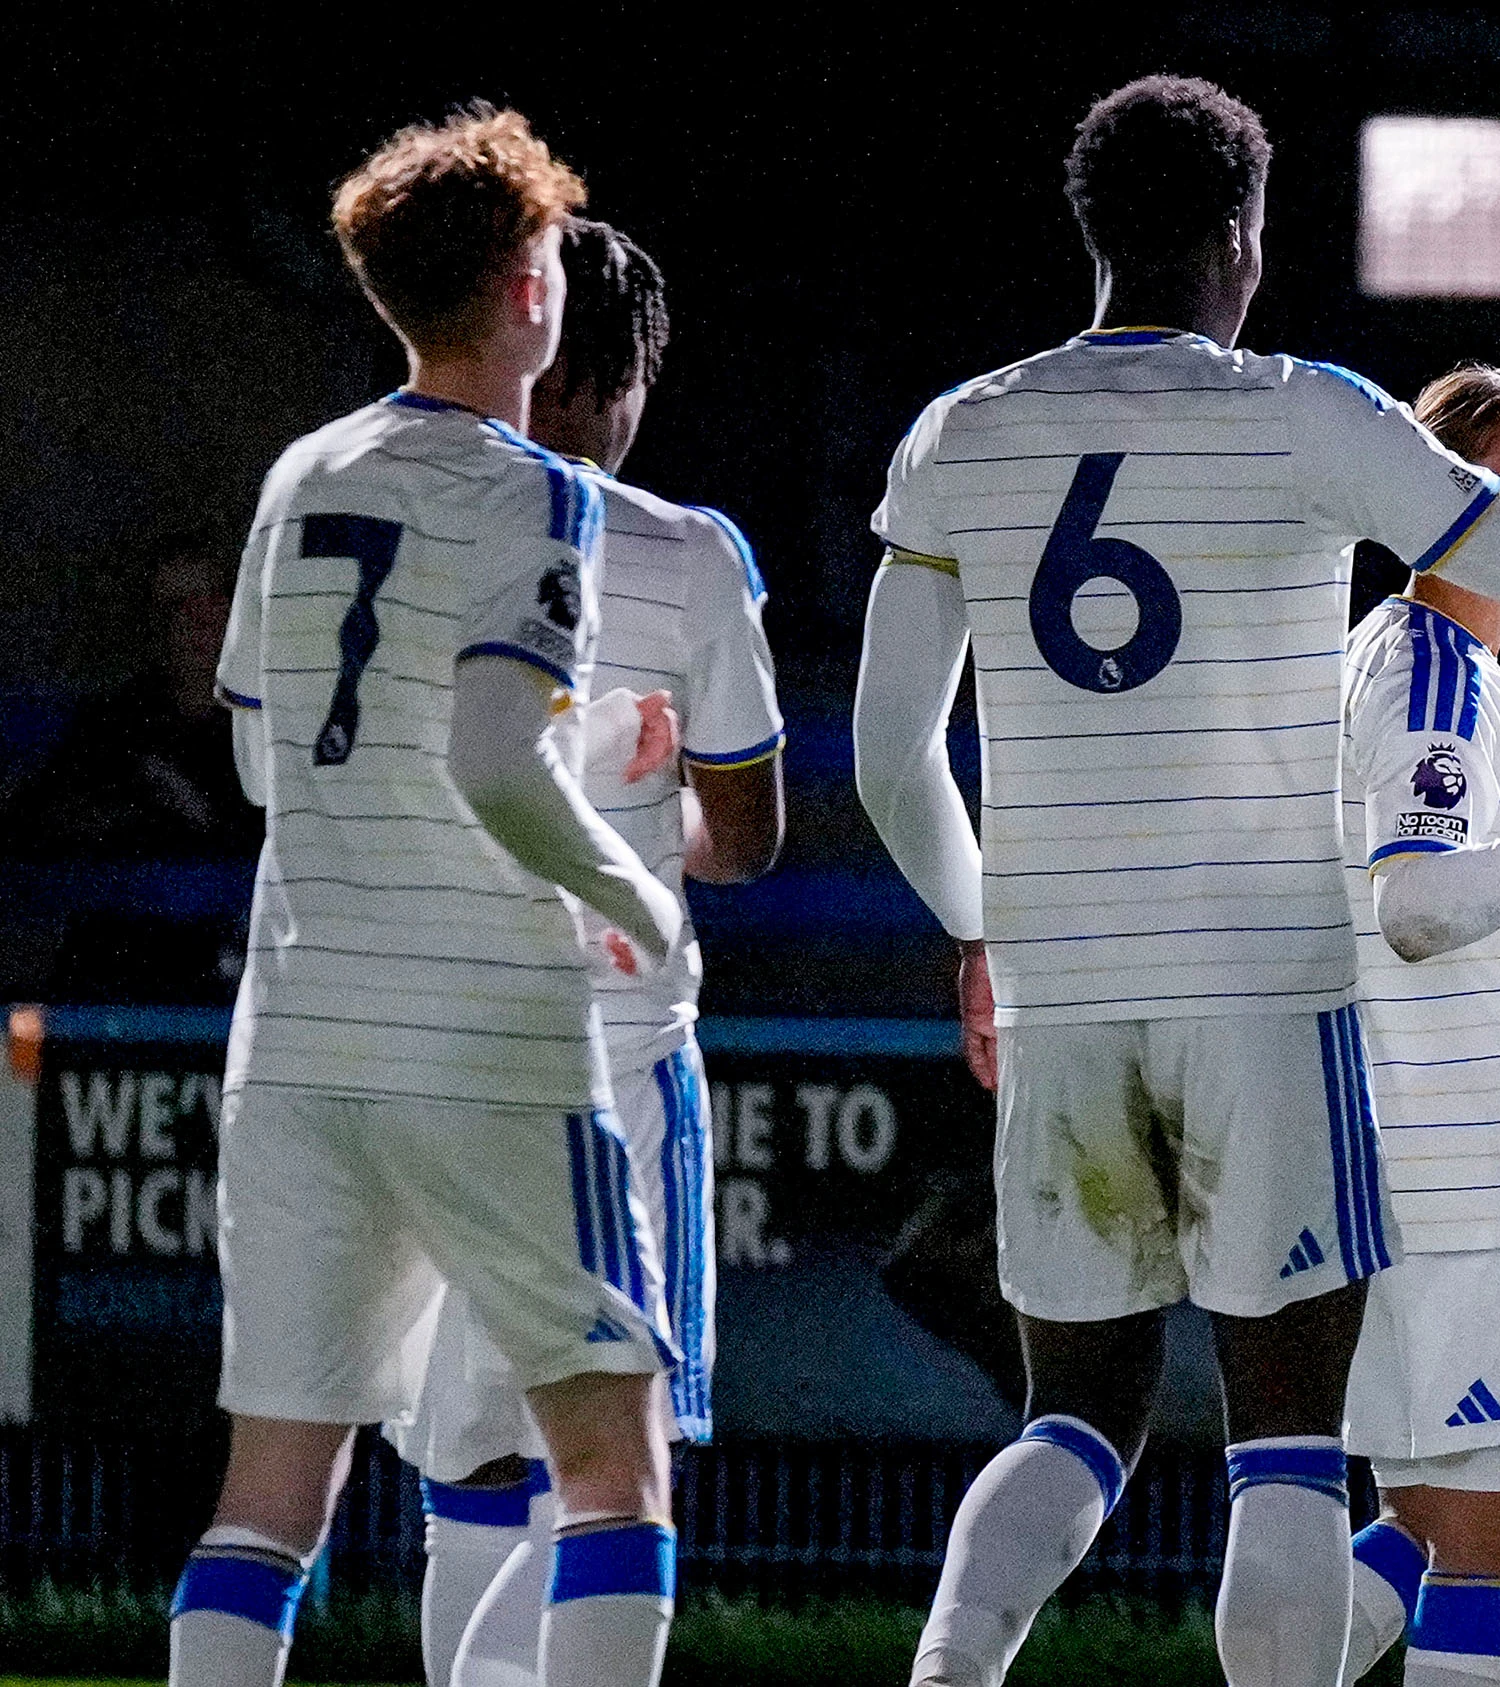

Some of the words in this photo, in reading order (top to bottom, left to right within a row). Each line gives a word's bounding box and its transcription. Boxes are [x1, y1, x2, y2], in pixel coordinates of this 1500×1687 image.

[1029, 452, 1183, 694] 6
[300, 512, 404, 766] 7
[1396, 825, 1418, 838] for
[1418, 825, 1467, 845] racism
[1397, 813, 1419, 826] No
[1420, 814, 1463, 831] room
[795, 1082, 899, 1175] TO
